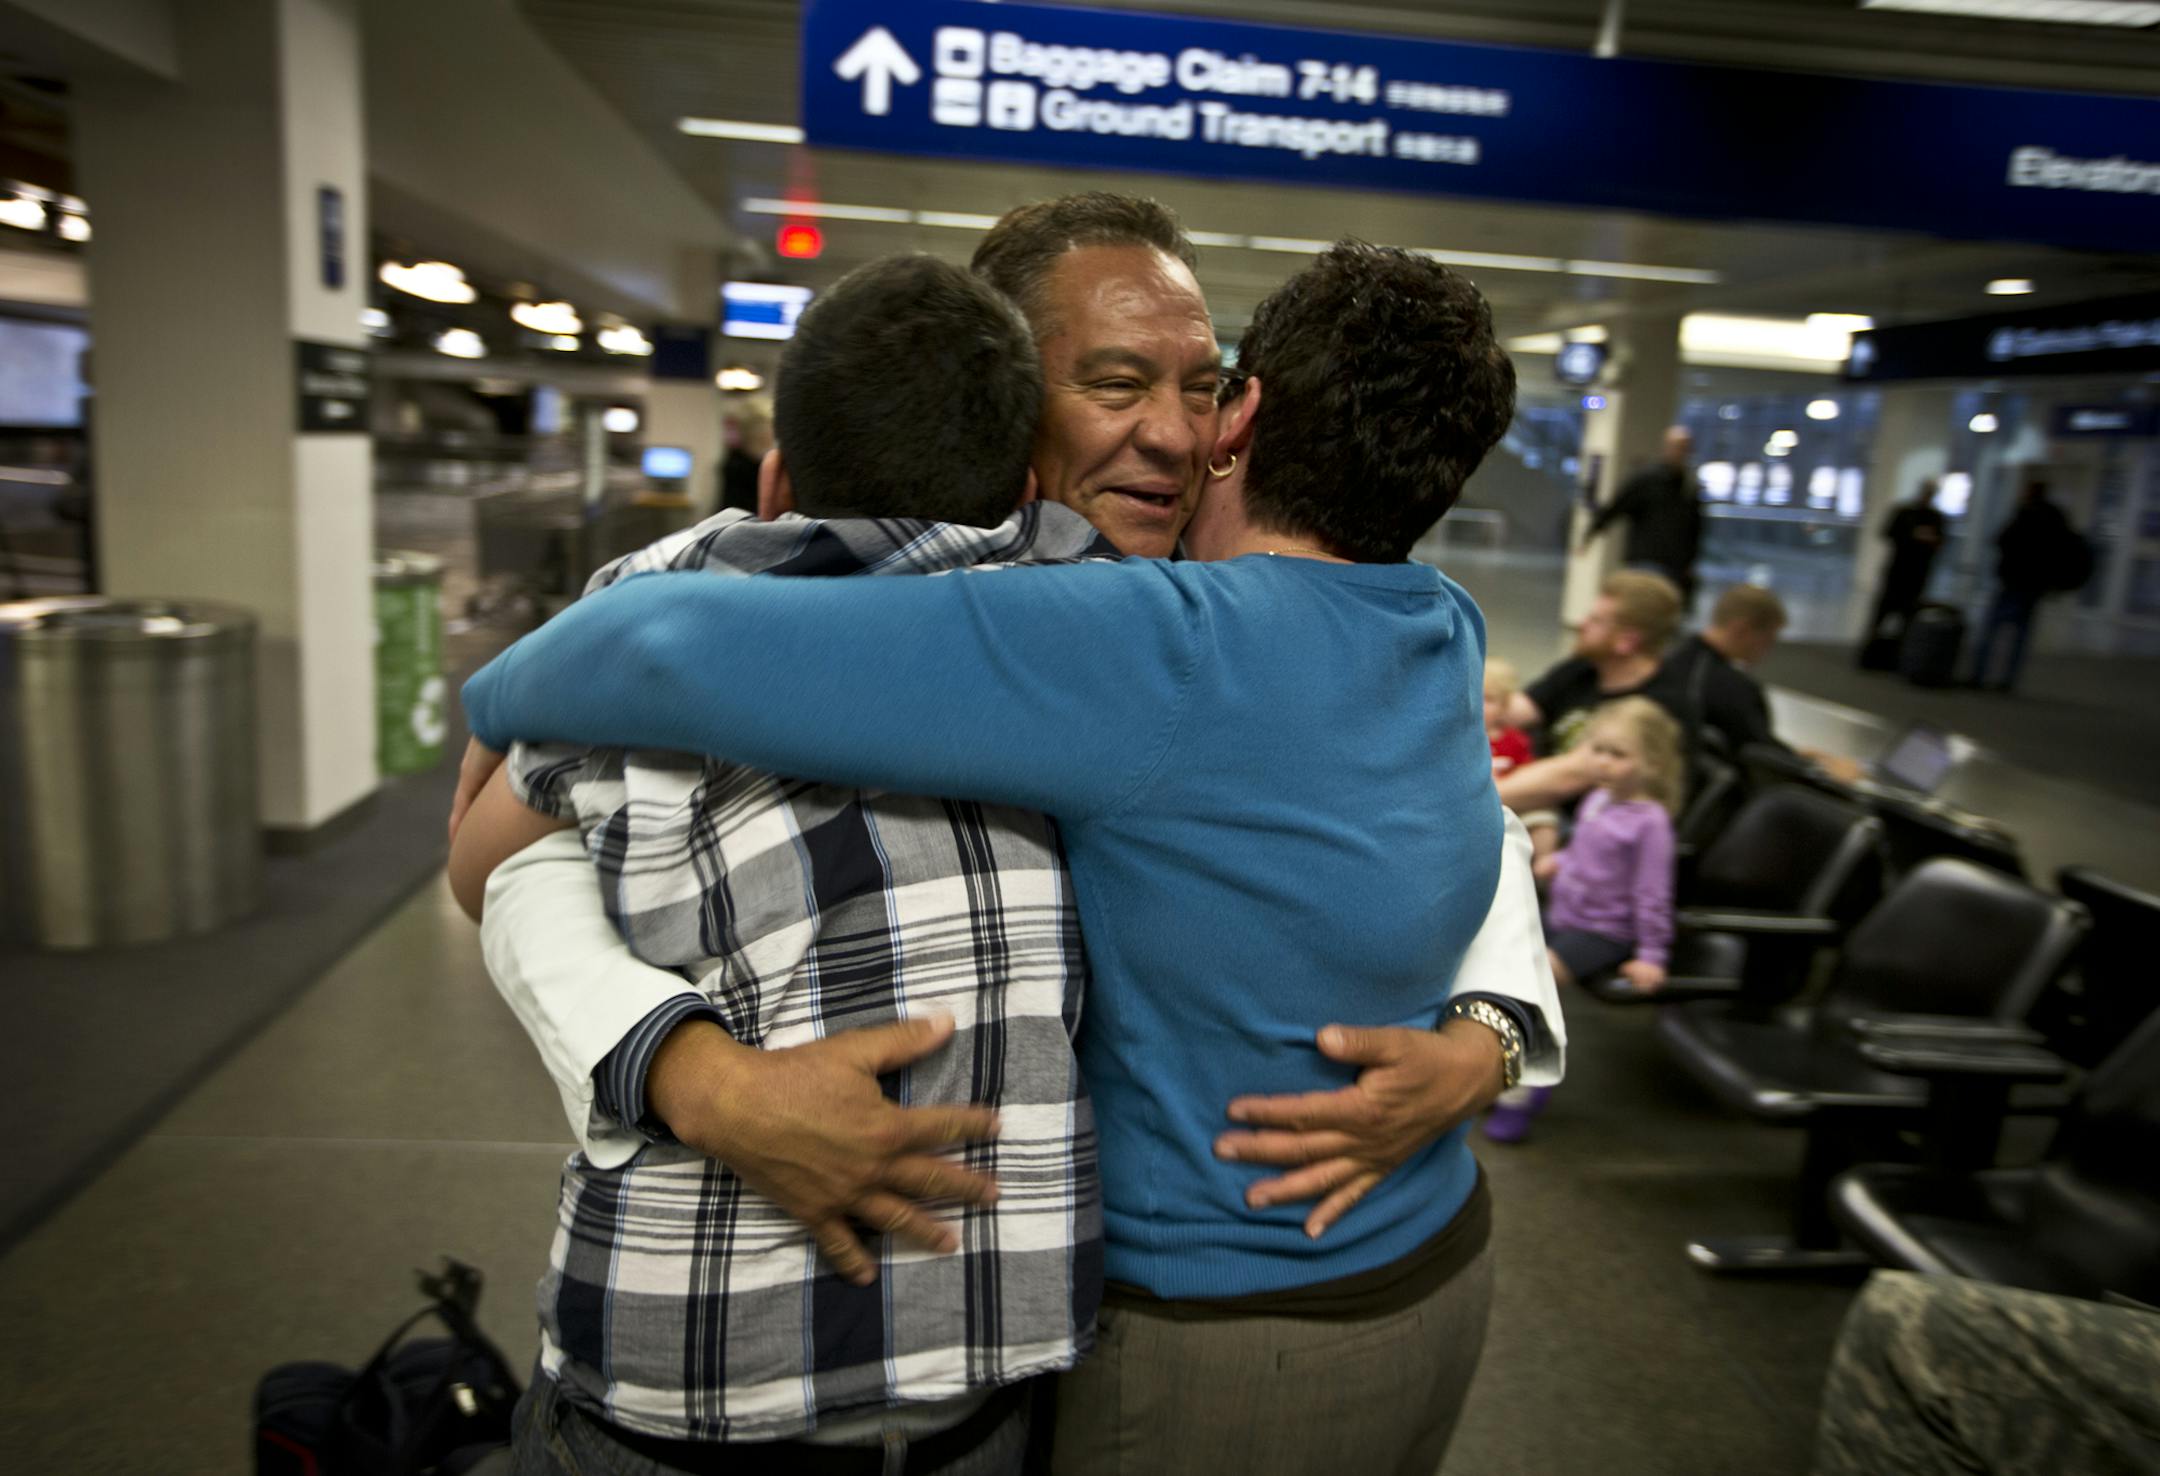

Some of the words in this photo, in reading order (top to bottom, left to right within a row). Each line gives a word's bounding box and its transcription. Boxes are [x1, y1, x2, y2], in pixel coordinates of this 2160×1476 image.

[989, 32, 1171, 94] Baggage
[1176, 47, 1292, 98] Claim
[1297, 60, 1378, 104] 7-14
[1040, 88, 1194, 140] Ground
[1199, 101, 1388, 160] Transport
